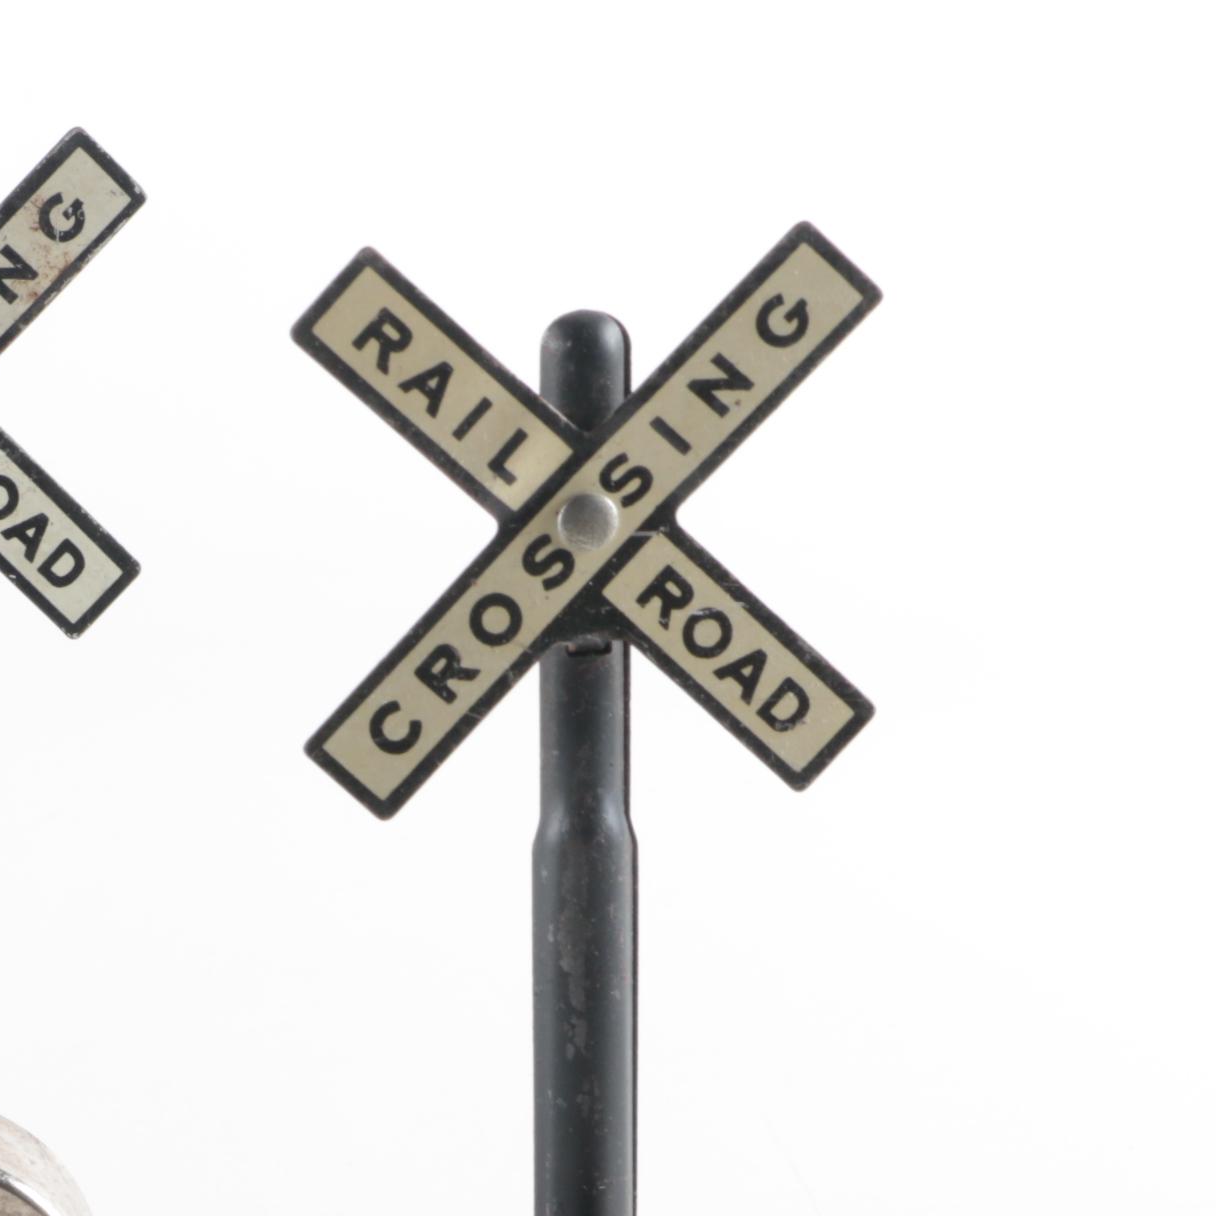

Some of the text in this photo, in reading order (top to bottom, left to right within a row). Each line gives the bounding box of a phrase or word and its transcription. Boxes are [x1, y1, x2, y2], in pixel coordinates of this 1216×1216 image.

[351, 306, 811, 732] RAIL ROAD
[369, 292, 809, 755] CROSSING
